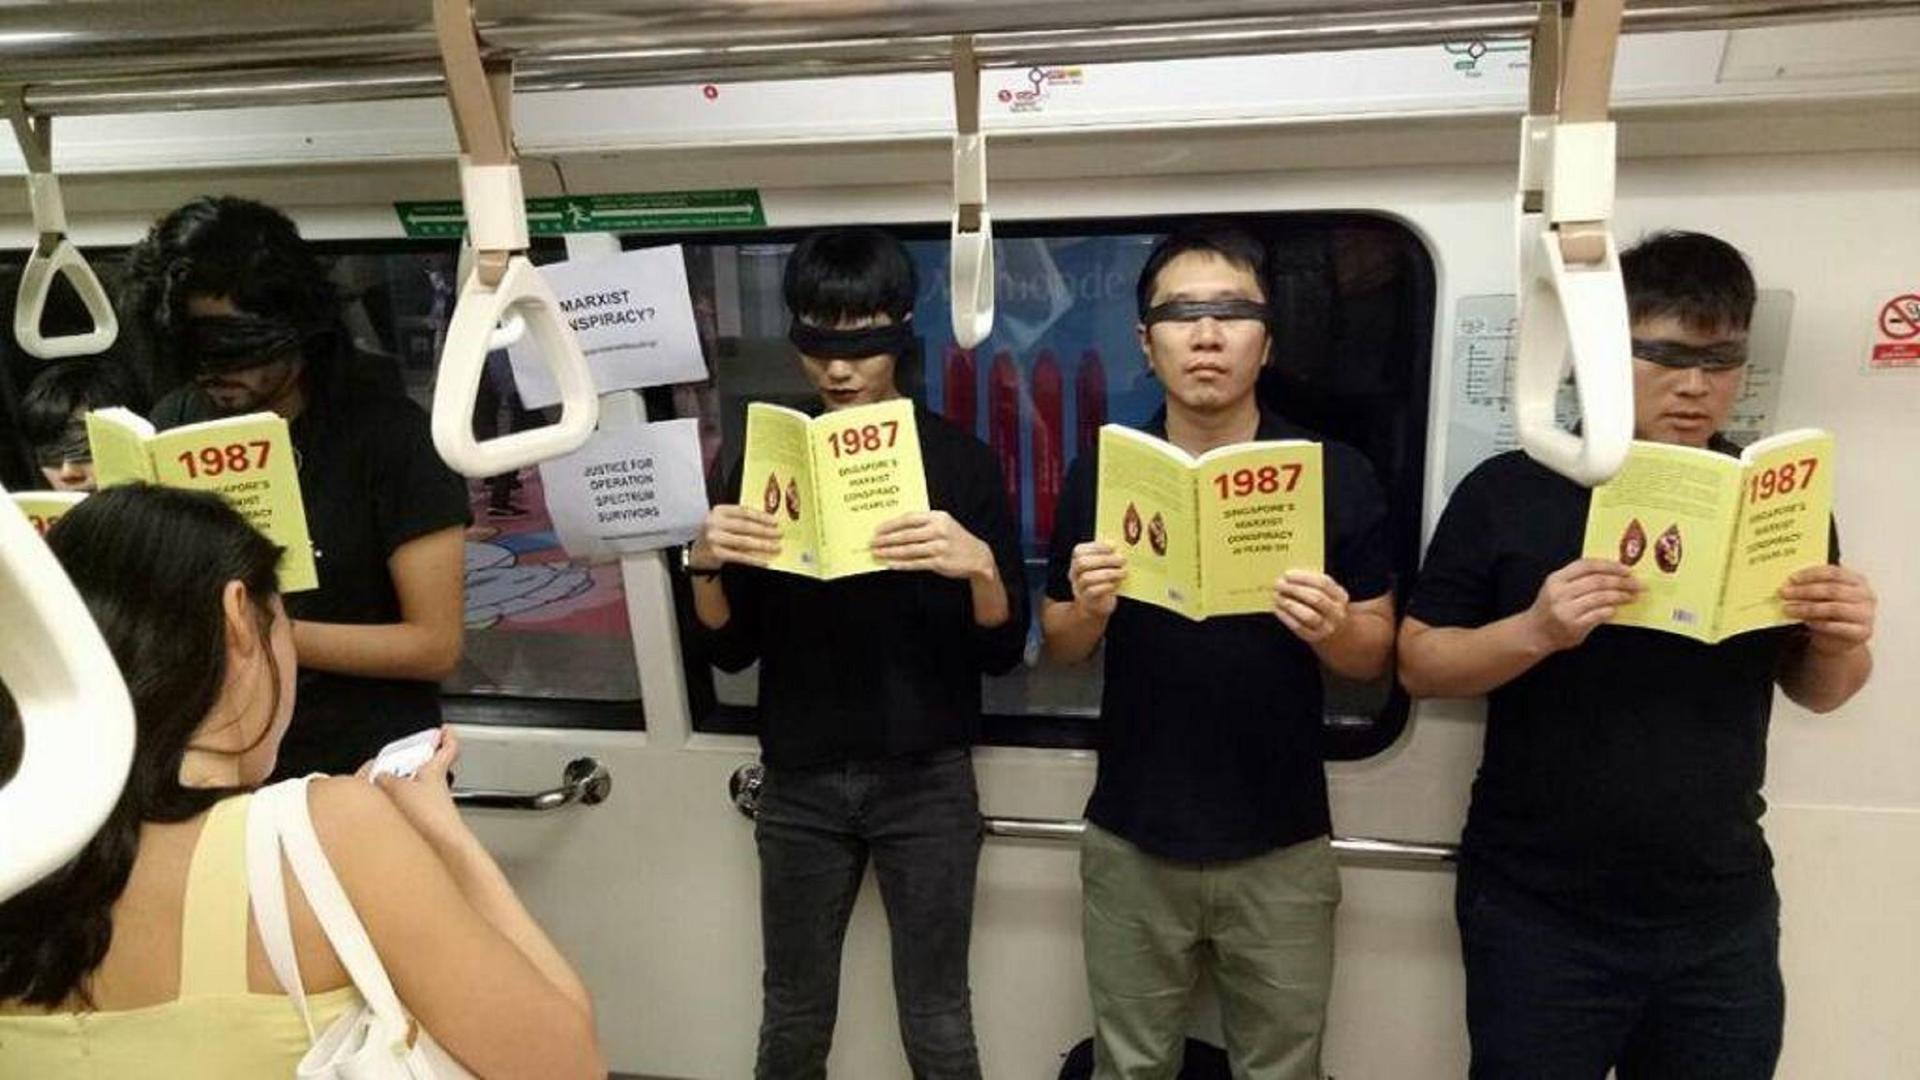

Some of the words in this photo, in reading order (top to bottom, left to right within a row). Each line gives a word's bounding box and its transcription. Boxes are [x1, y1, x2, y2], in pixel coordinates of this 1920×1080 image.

[559, 290, 631, 312] MARXIST
[568, 307, 656, 331] NSPIRACY?
[828, 420, 898, 458] 1987
[178, 440, 271, 479] 1987
[584, 461, 628, 477] JUSTICE
[631, 458, 653, 470] FOR
[590, 475, 653, 490] OPERATION
[1214, 464, 1303, 499] 1987
[1750, 458, 1818, 504] 1987
[594, 491, 655, 507] SPECTRUM
[598, 507, 660, 523] SURVIVORS
[1222, 503, 1296, 519] SINGAPORE'S
[1235, 517, 1283, 529] MARXIST
[1227, 531, 1293, 544] CONSPIRACY
